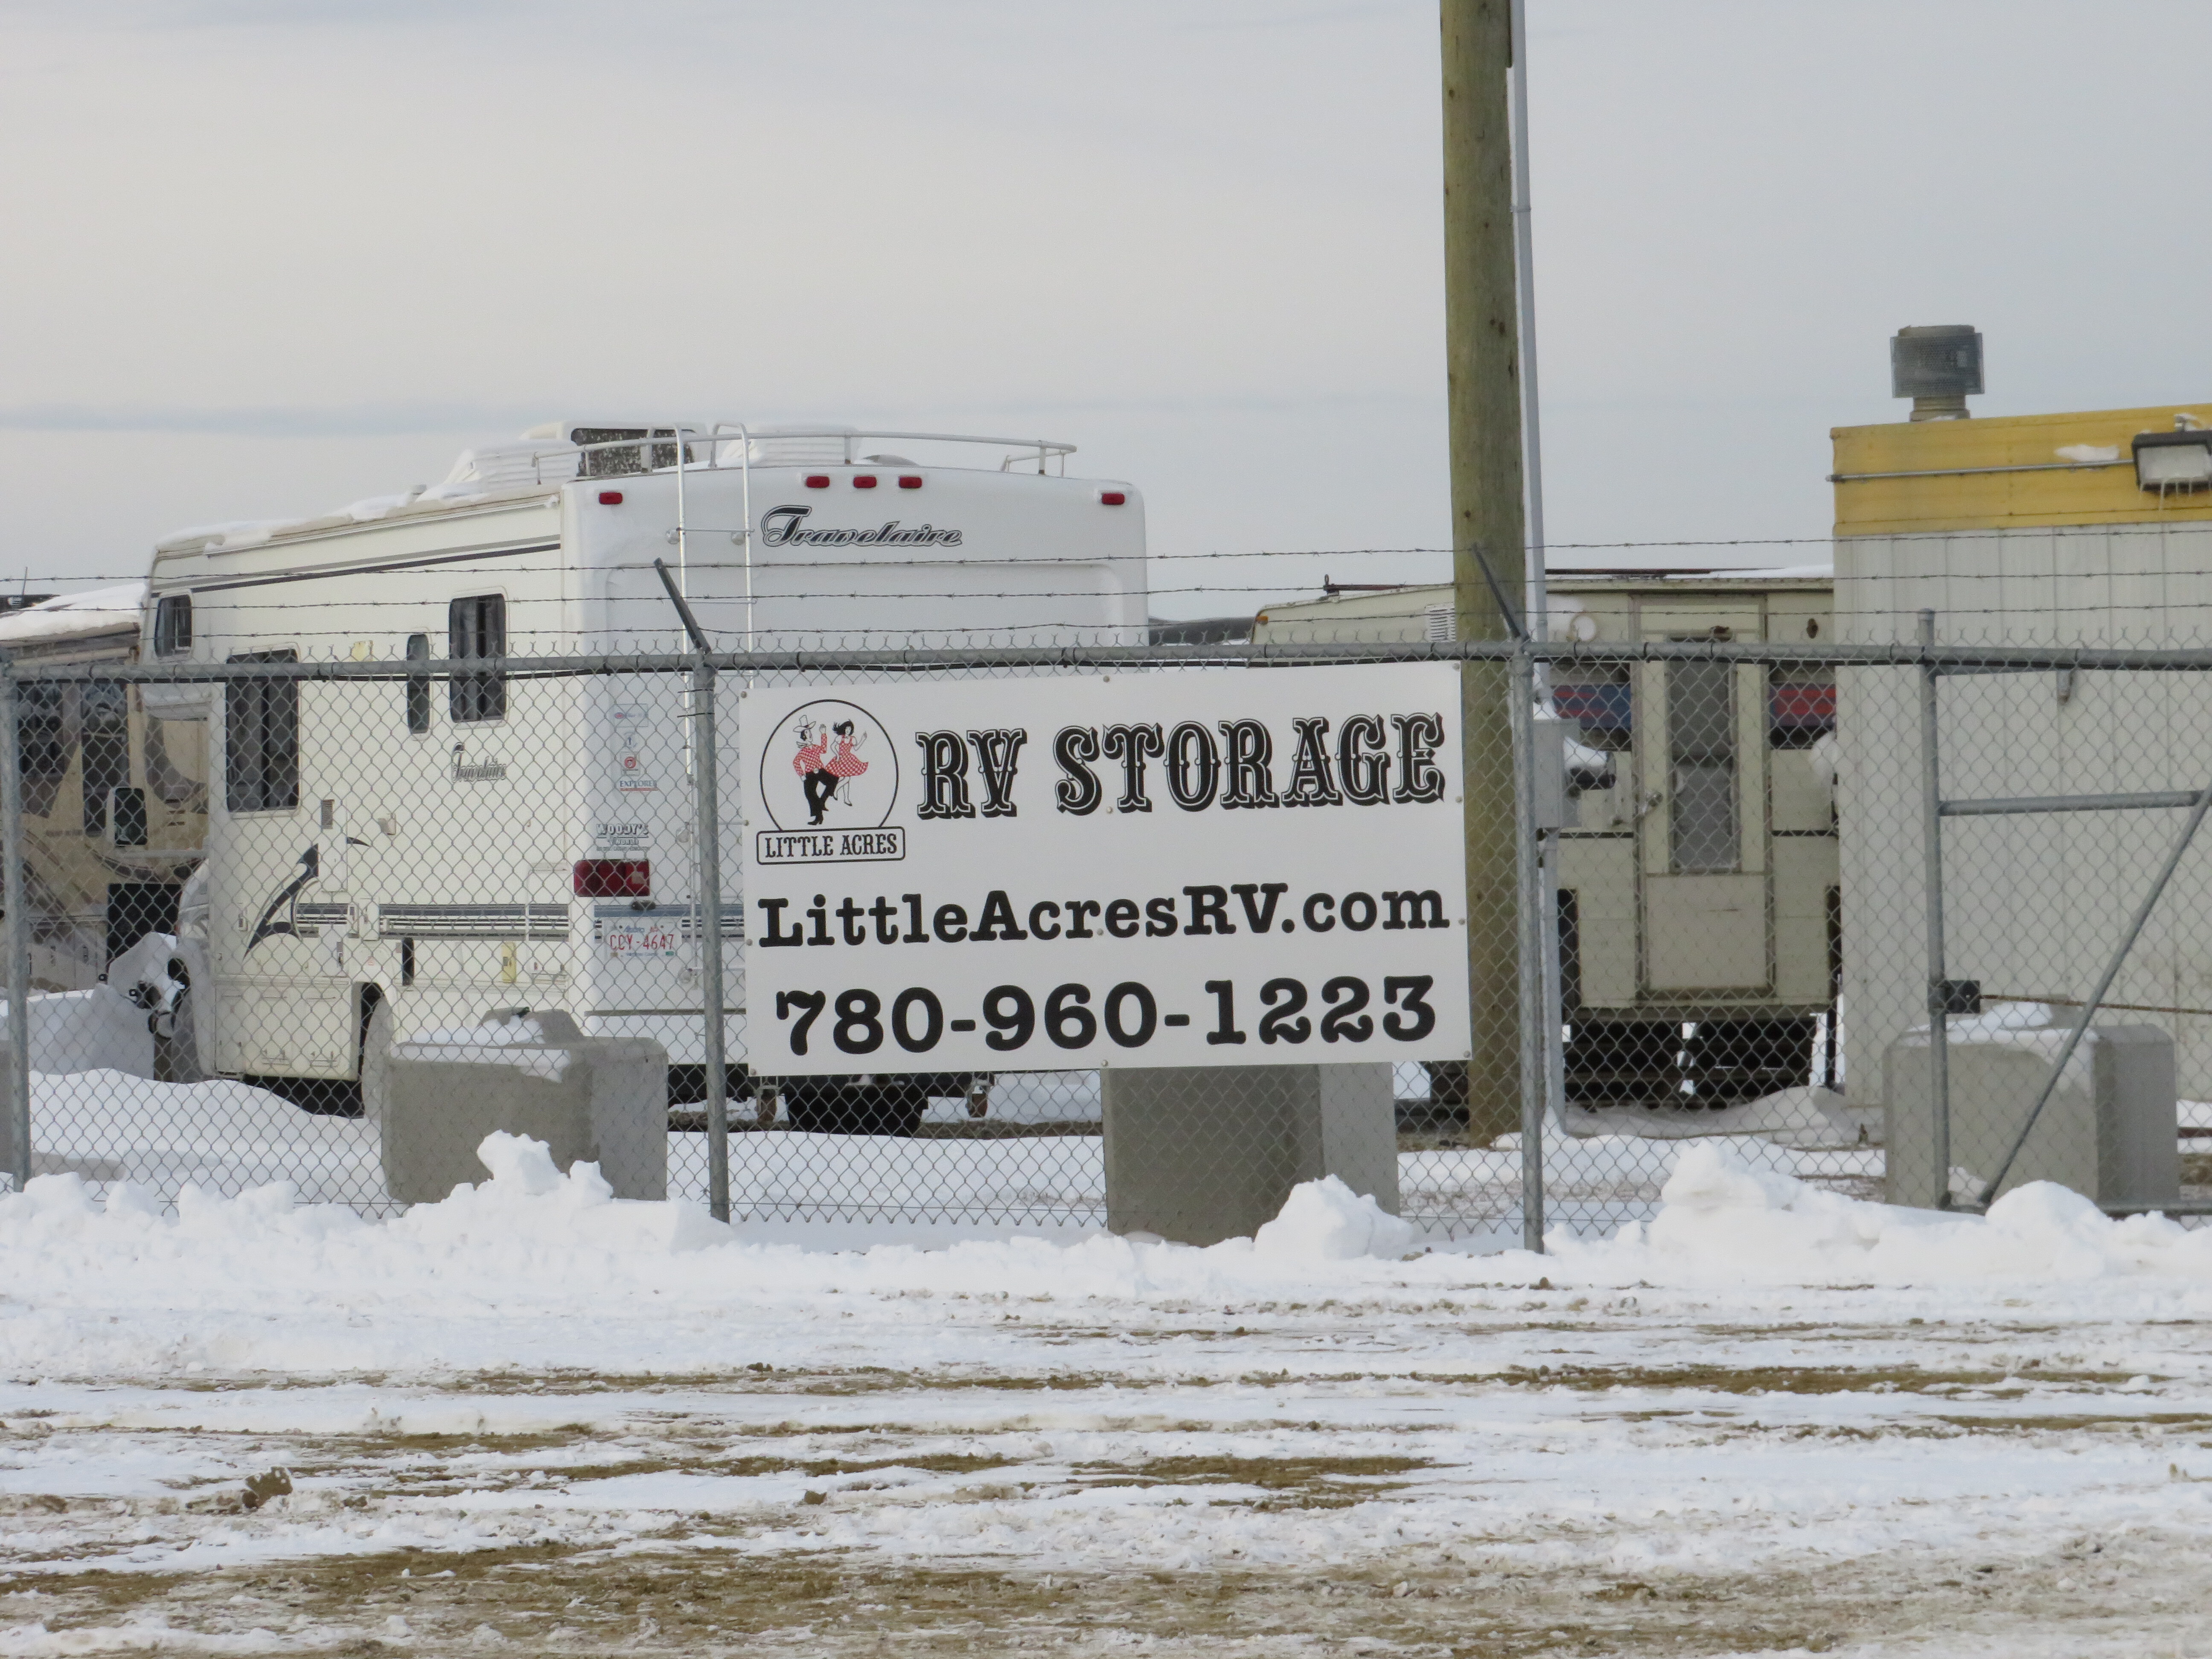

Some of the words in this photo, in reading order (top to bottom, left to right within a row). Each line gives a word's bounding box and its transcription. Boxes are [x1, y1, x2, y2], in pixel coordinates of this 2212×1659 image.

[761, 505, 963, 548] Travelaire
[915, 729, 1026, 819] RV
[1053, 712, 1445, 815] STORAGE
[765, 836, 834, 858] LITTLE
[840, 833, 897, 856] ACRES
[758, 883, 1450, 947] LittleAcresRV.com
[775, 975, 1436, 1056] 780-960-1223
